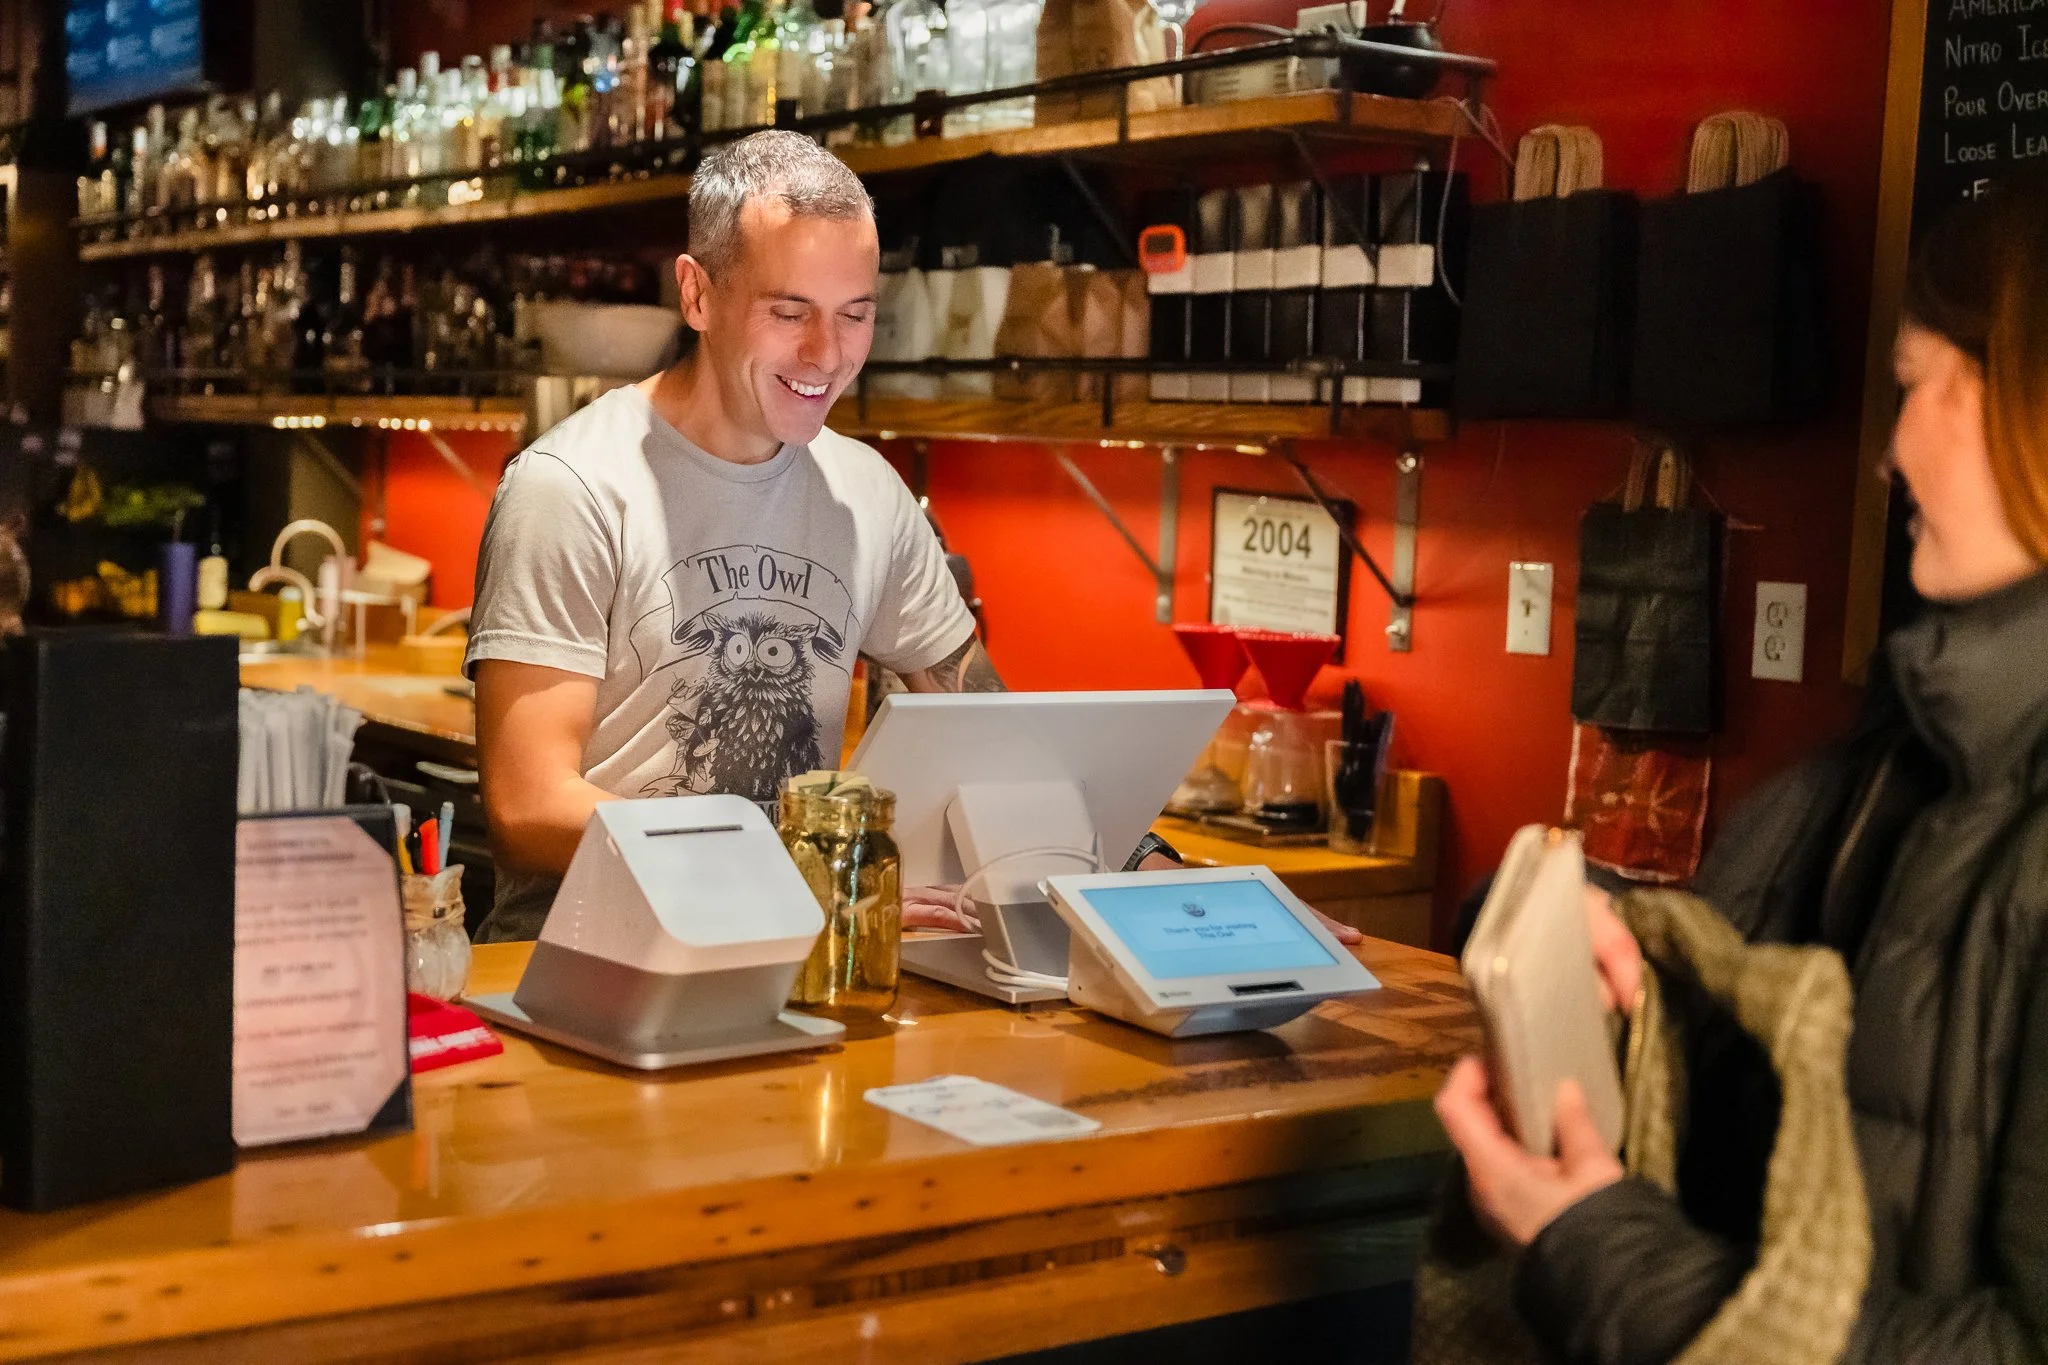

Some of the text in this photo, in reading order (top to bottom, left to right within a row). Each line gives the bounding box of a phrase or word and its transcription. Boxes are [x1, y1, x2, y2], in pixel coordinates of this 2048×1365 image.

[1944, 34, 2002, 69] NITRO
[1944, 85, 1988, 119] POUR
[1944, 131, 1997, 164] LOOSE
[1242, 517, 1312, 559] 2004
[697, 554, 813, 599] The Owl
